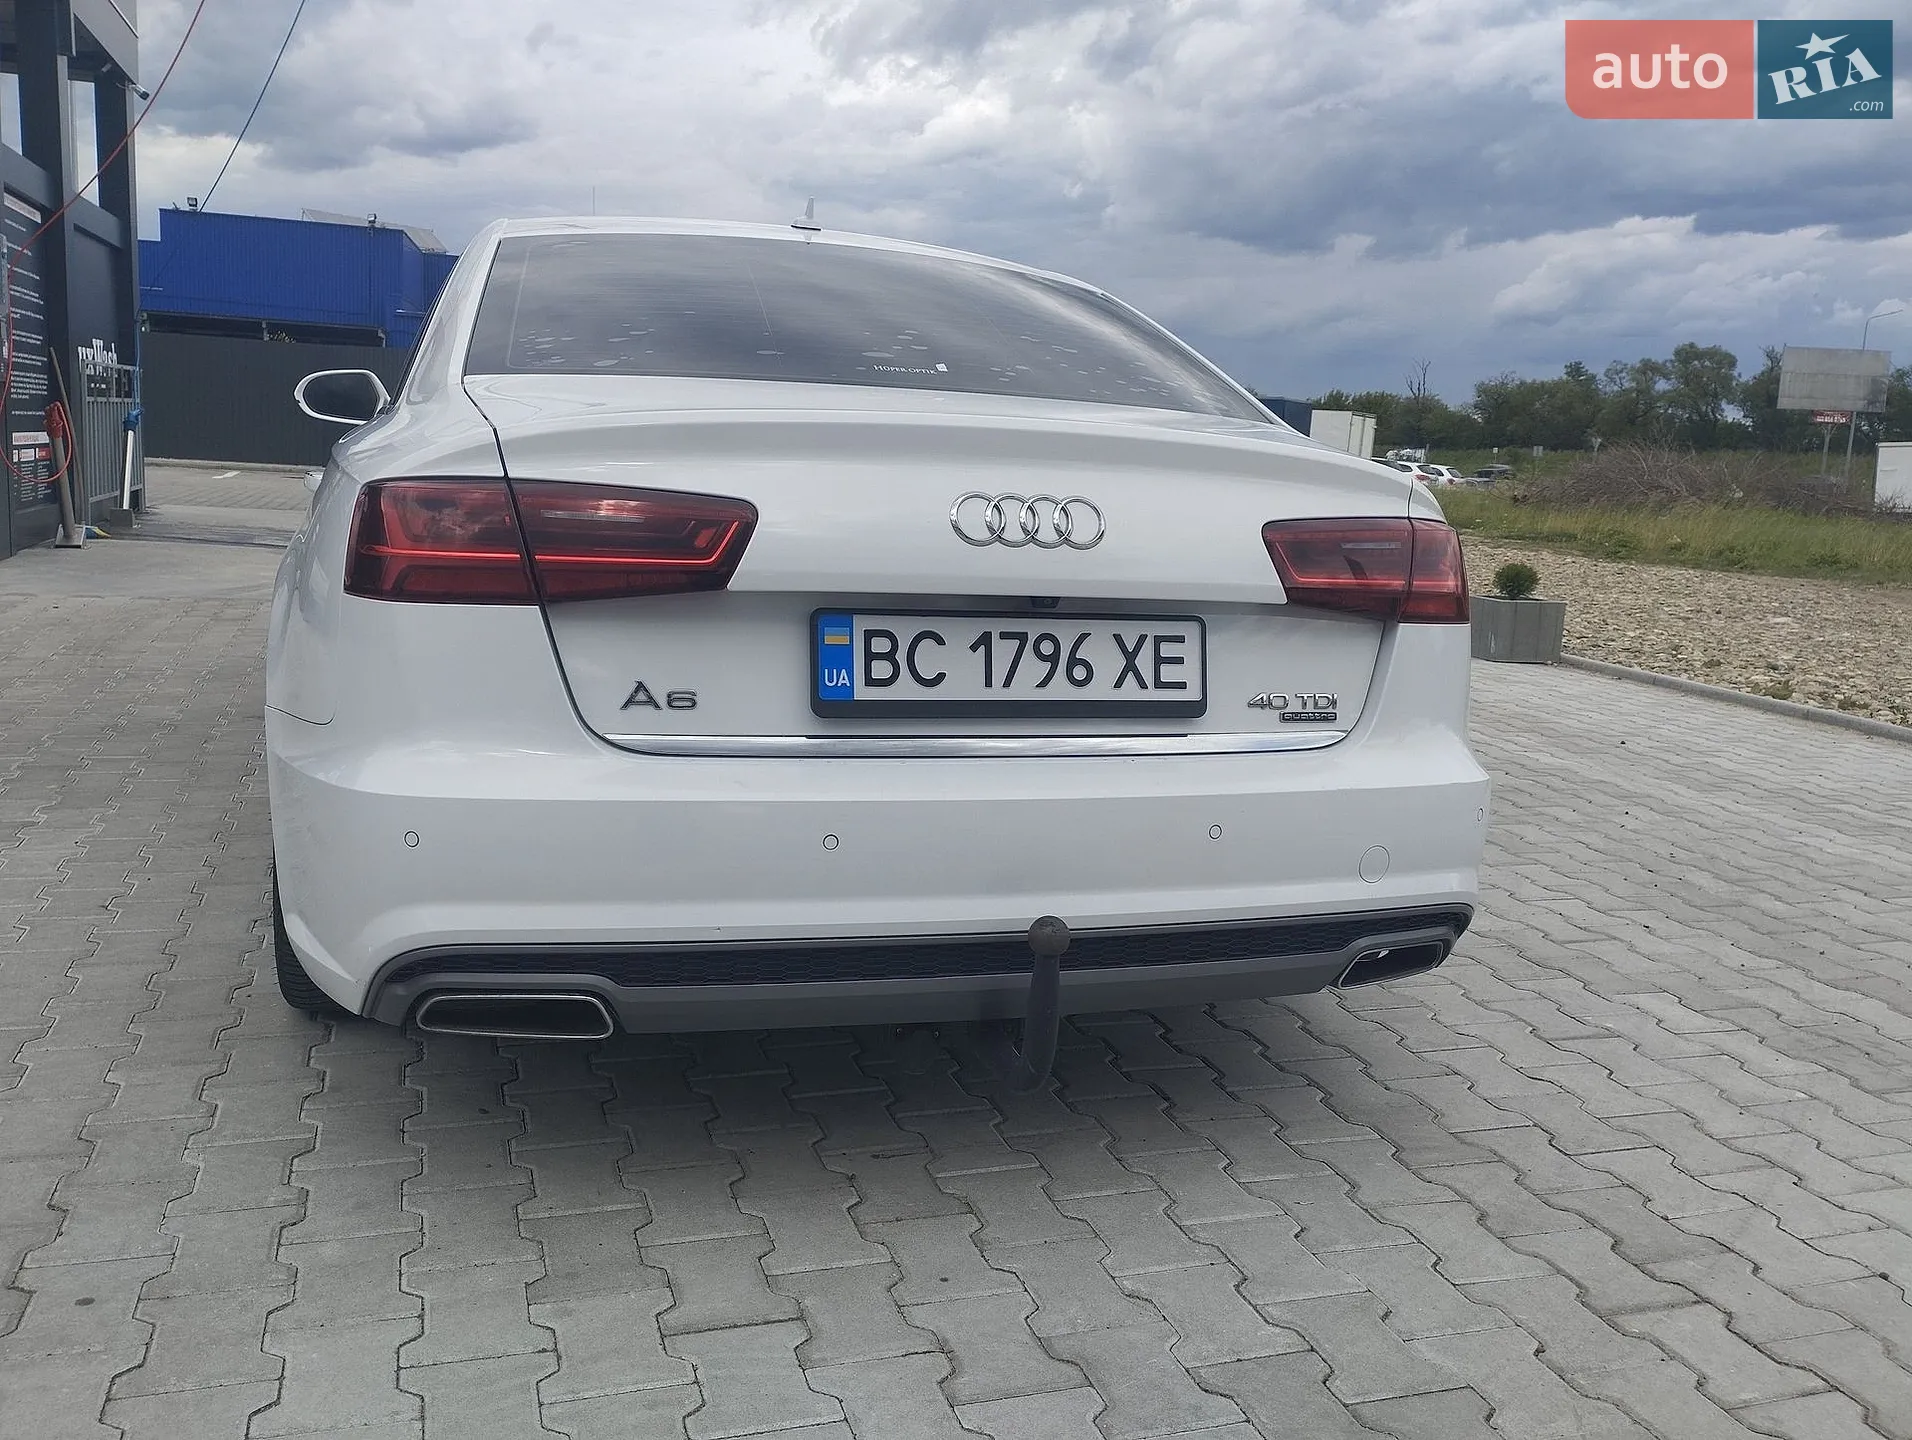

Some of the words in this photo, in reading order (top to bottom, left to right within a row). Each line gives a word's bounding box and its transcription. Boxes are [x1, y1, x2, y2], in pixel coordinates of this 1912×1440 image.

[863, 628, 947, 689] BC
[968, 630, 1095, 689] 1796
[1112, 632, 1188, 690] XE
[824, 668, 851, 688] UA
[620, 679, 697, 710] A6
[1247, 692, 1289, 710] 40
[1295, 692, 1338, 710] TDI
[1283, 712, 1336, 721] quattro
